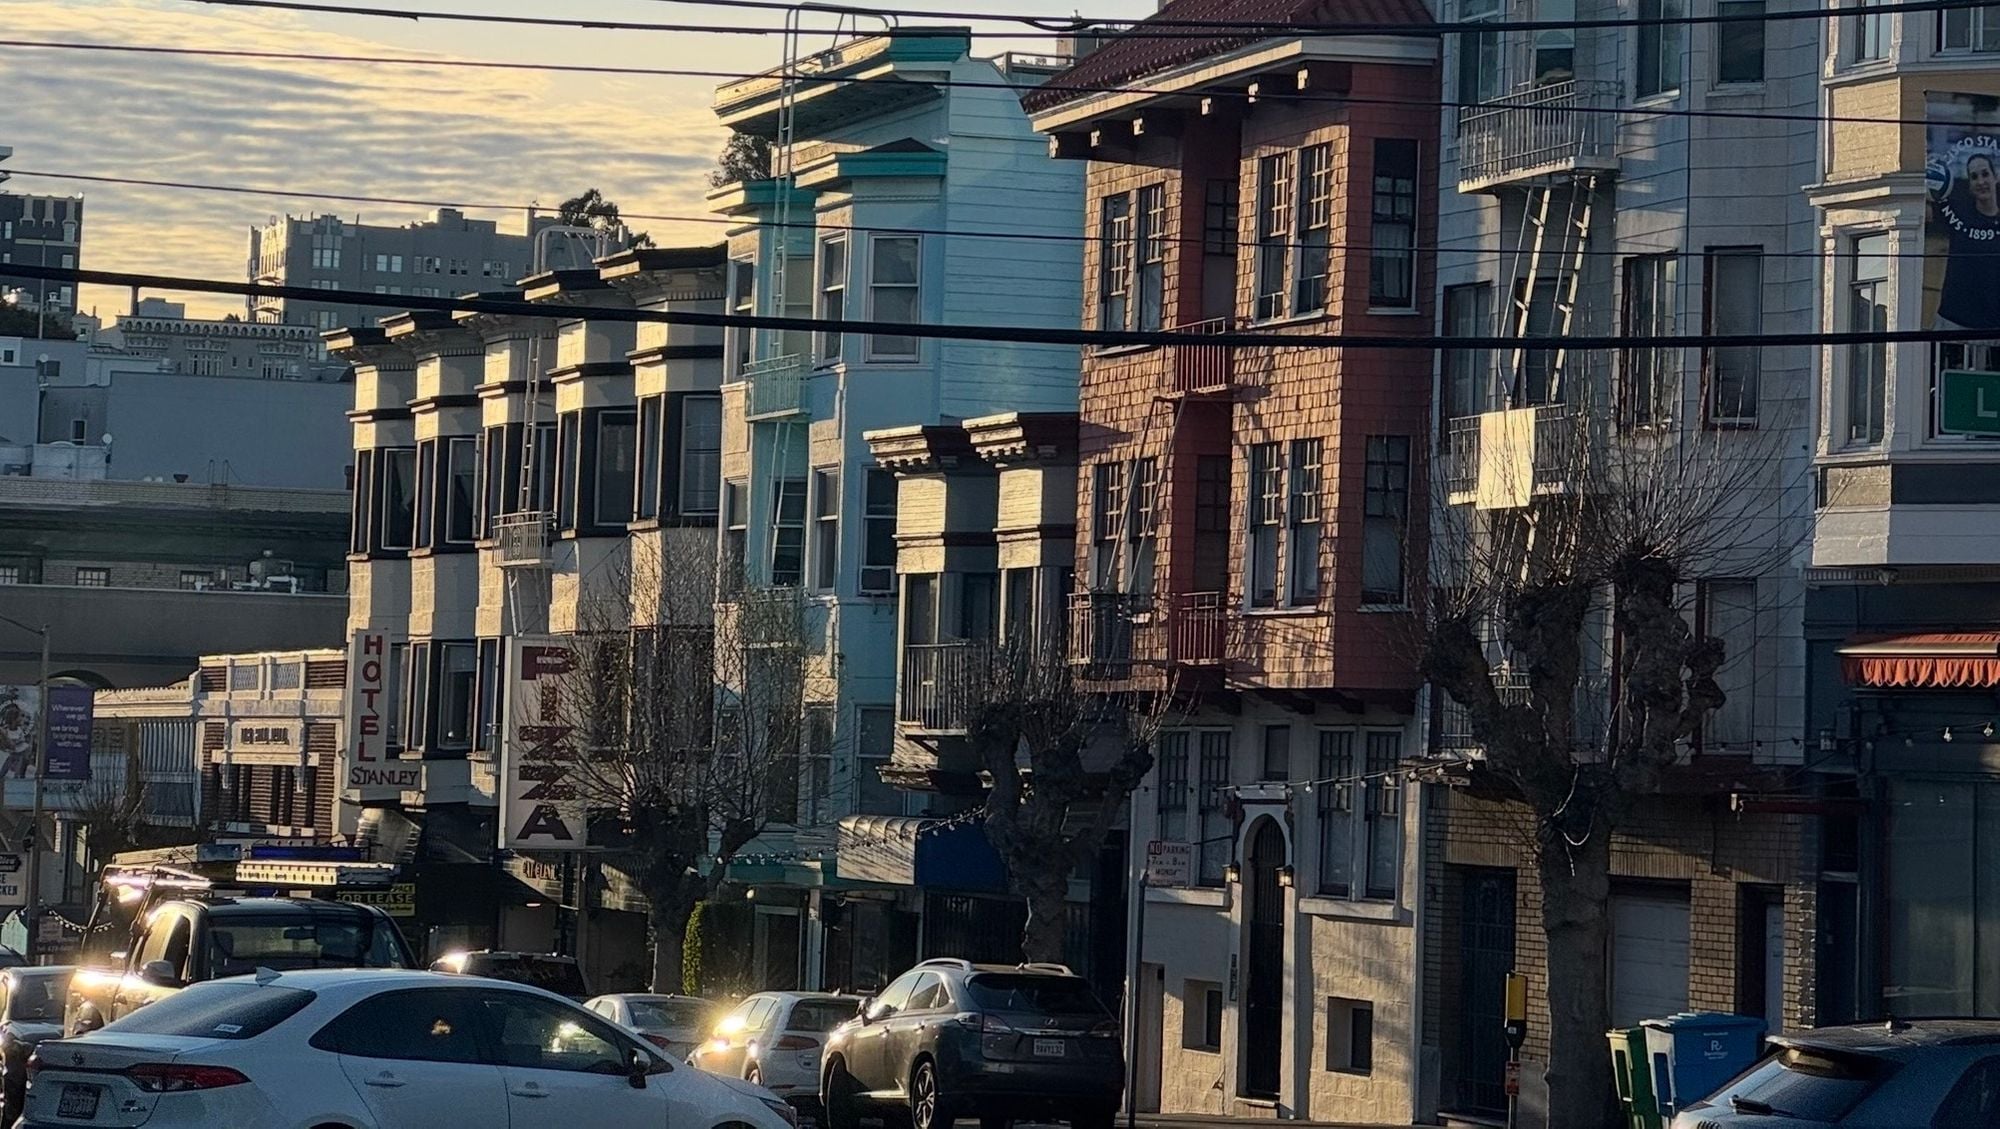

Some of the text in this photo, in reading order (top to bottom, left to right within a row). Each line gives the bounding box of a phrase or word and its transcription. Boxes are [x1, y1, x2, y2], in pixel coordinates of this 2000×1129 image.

[1941, 204, 1964, 231] SAN
[1976, 135, 2000, 152] STA
[1968, 227, 1995, 241] 1899
[358, 634, 384, 762] HOTEL
[51, 704, 86, 712] Wherever
[62, 725, 79, 734] bring
[515, 646, 580, 841] PIZZA
[350, 766, 420, 787] STANLEY
[1149, 841, 1190, 855] NO PARKING
[366, 893, 414, 904] LEASE
